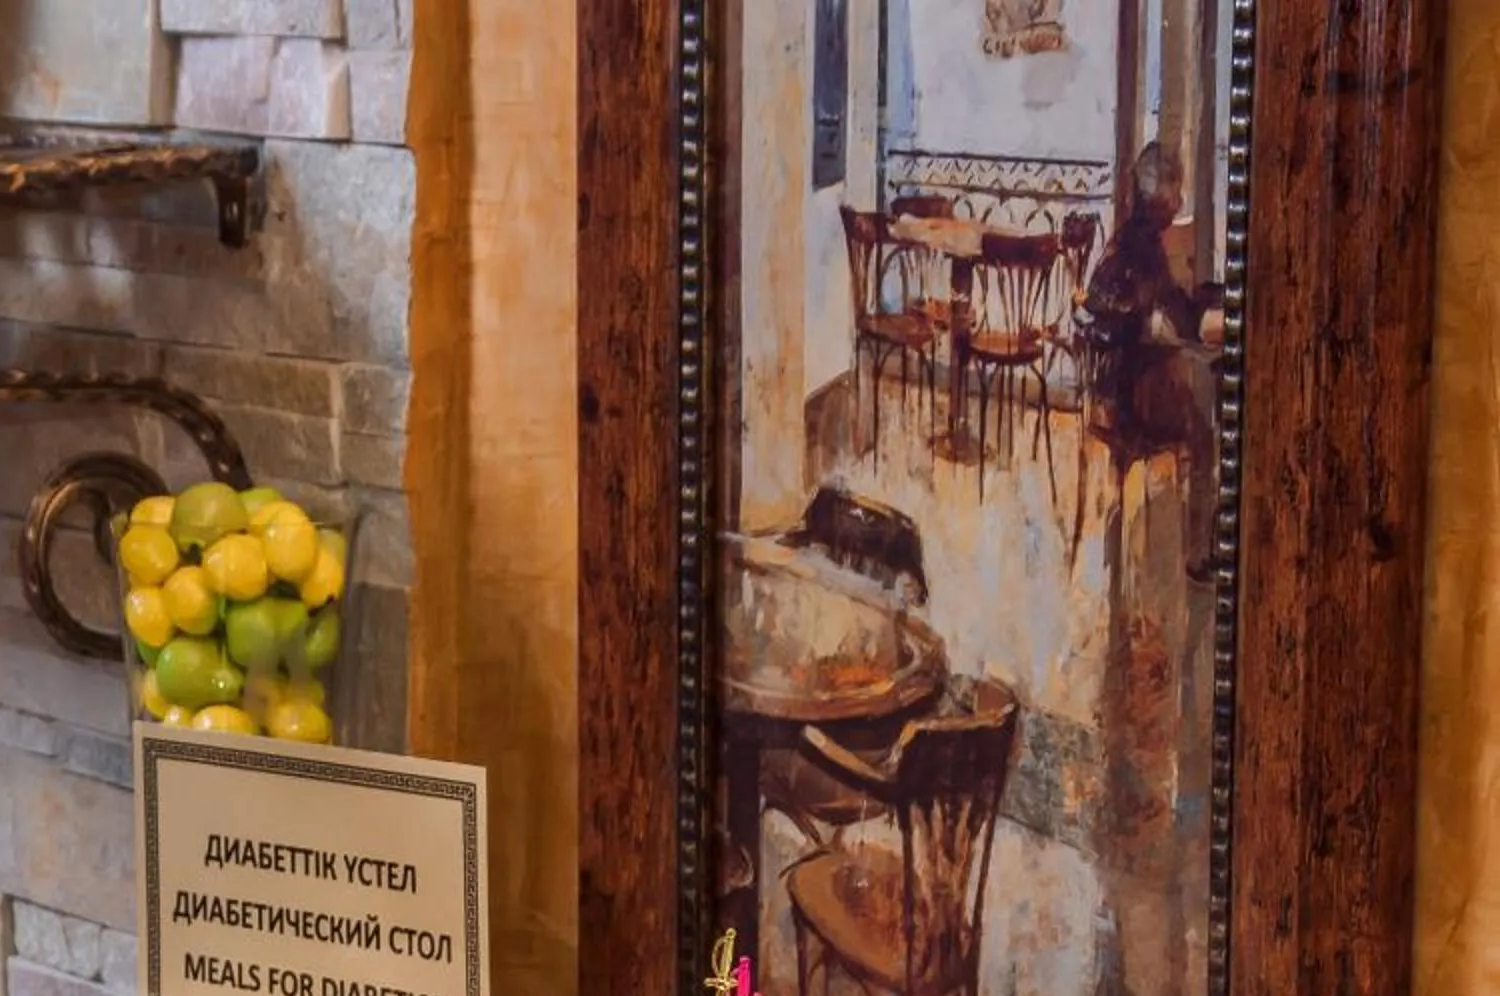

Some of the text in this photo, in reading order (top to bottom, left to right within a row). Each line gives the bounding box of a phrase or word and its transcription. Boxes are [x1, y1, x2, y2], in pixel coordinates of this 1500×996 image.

[204, 834, 336, 880] ДИАБЕТТІК
[173, 890, 452, 964] ДИАБЕТИЧЕСКИЙ СТОЛ
[184, 953, 260, 991] MEALS
